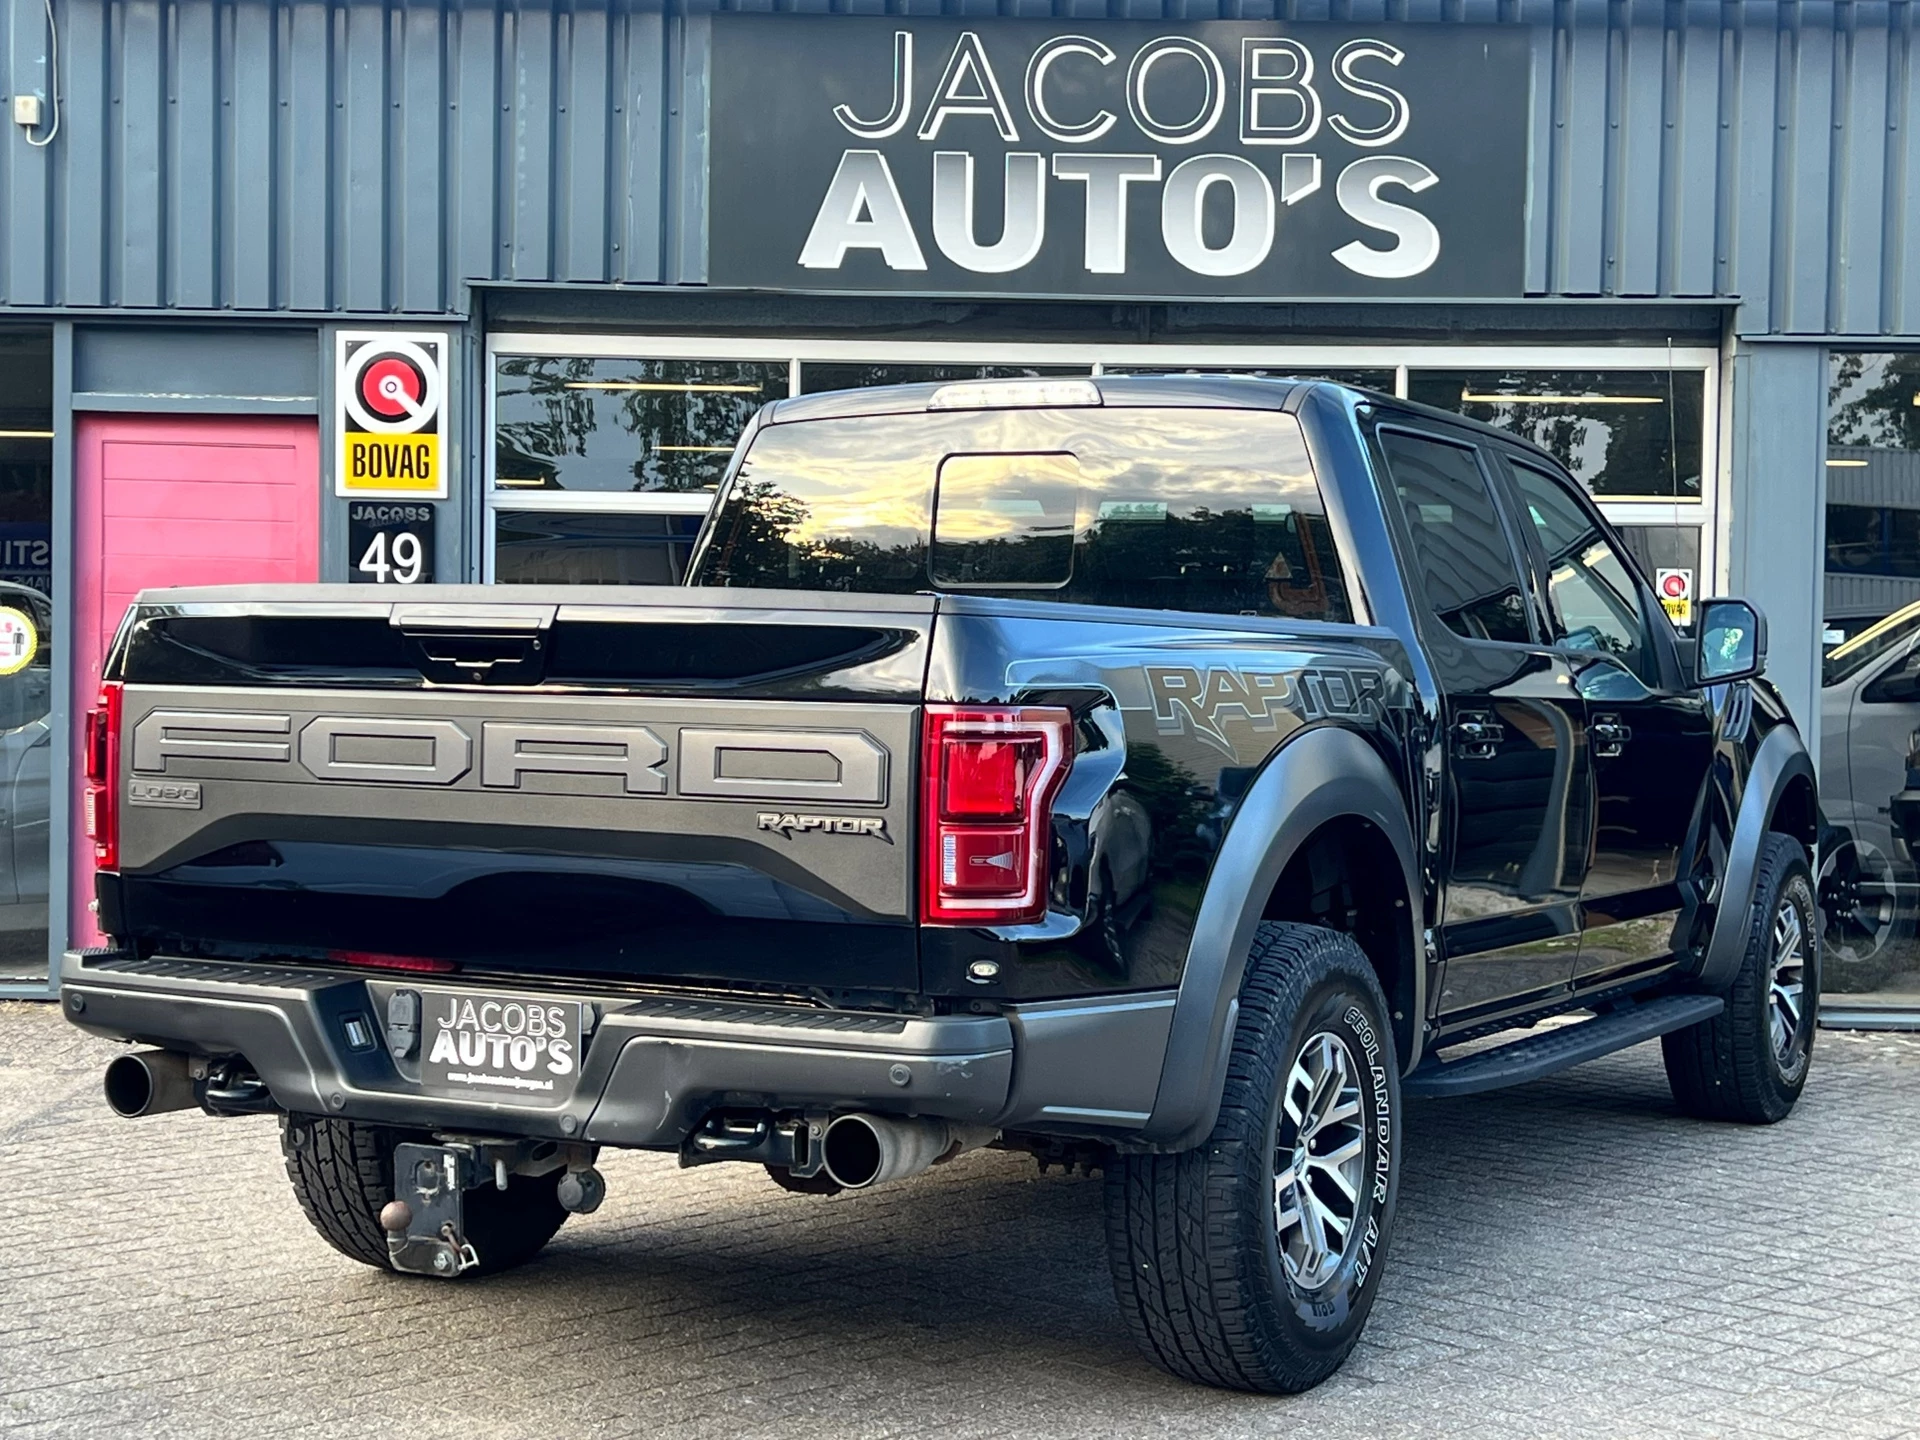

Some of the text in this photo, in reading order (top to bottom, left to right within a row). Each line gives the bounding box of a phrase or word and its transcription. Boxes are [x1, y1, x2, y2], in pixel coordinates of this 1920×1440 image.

[832, 30, 1410, 148] JACOBS
[798, 149, 1441, 280] AUTO'S
[352, 443, 430, 480] BOVAG
[351, 505, 431, 522] JACOBS
[358, 531, 422, 584] 49
[1664, 603, 1686, 615] OVAG
[1143, 663, 1397, 750] RAPTOR
[132, 709, 887, 804] FORD
[757, 812, 894, 845] RAPTOR
[437, 998, 566, 1038] JACOBS
[429, 1029, 573, 1075] AUTO'S
[1343, 1006, 1390, 1288] GEOLANDAR A/T
